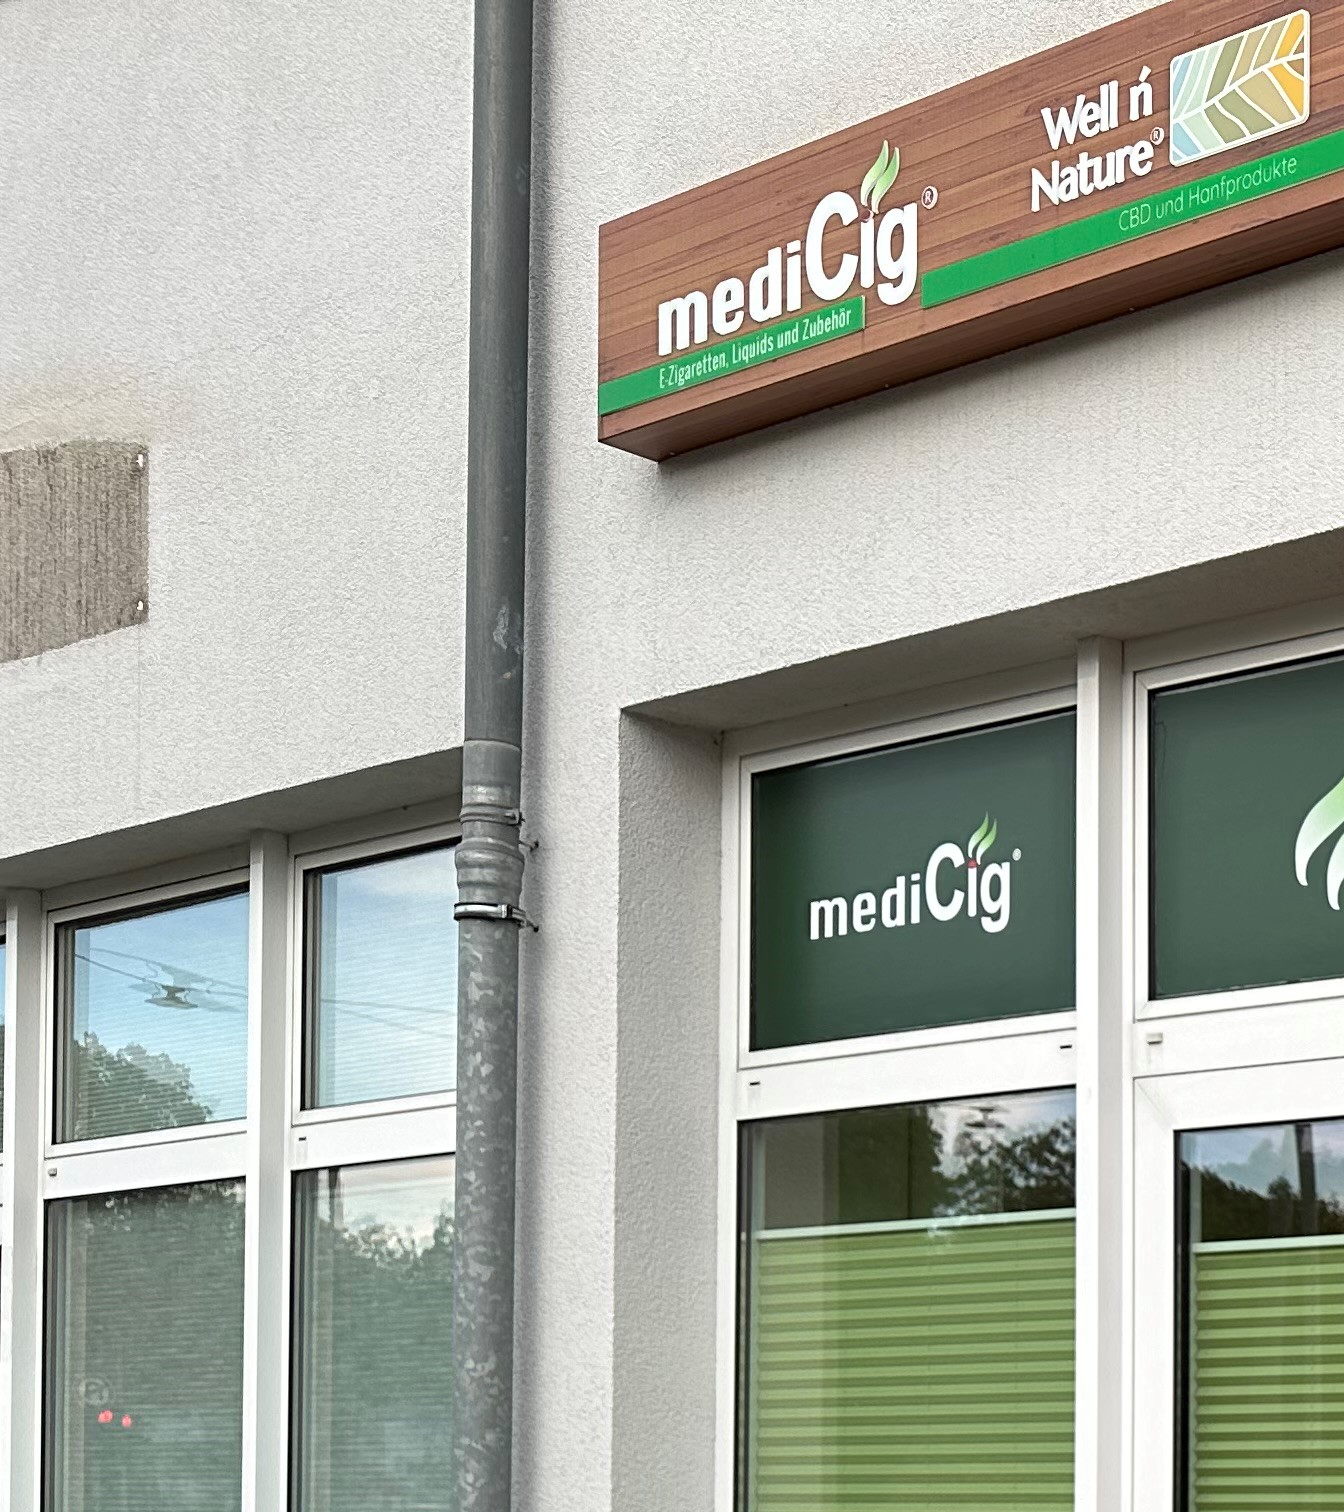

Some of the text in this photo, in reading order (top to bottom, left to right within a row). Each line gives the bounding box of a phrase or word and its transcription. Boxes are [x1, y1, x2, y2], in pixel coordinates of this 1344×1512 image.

[1041, 80, 1119, 150] Well
[1118, 155, 1297, 231] CBD und Hanfprodukte
[659, 307, 851, 389] E-Zigaretten, Liquids und Zubehör
